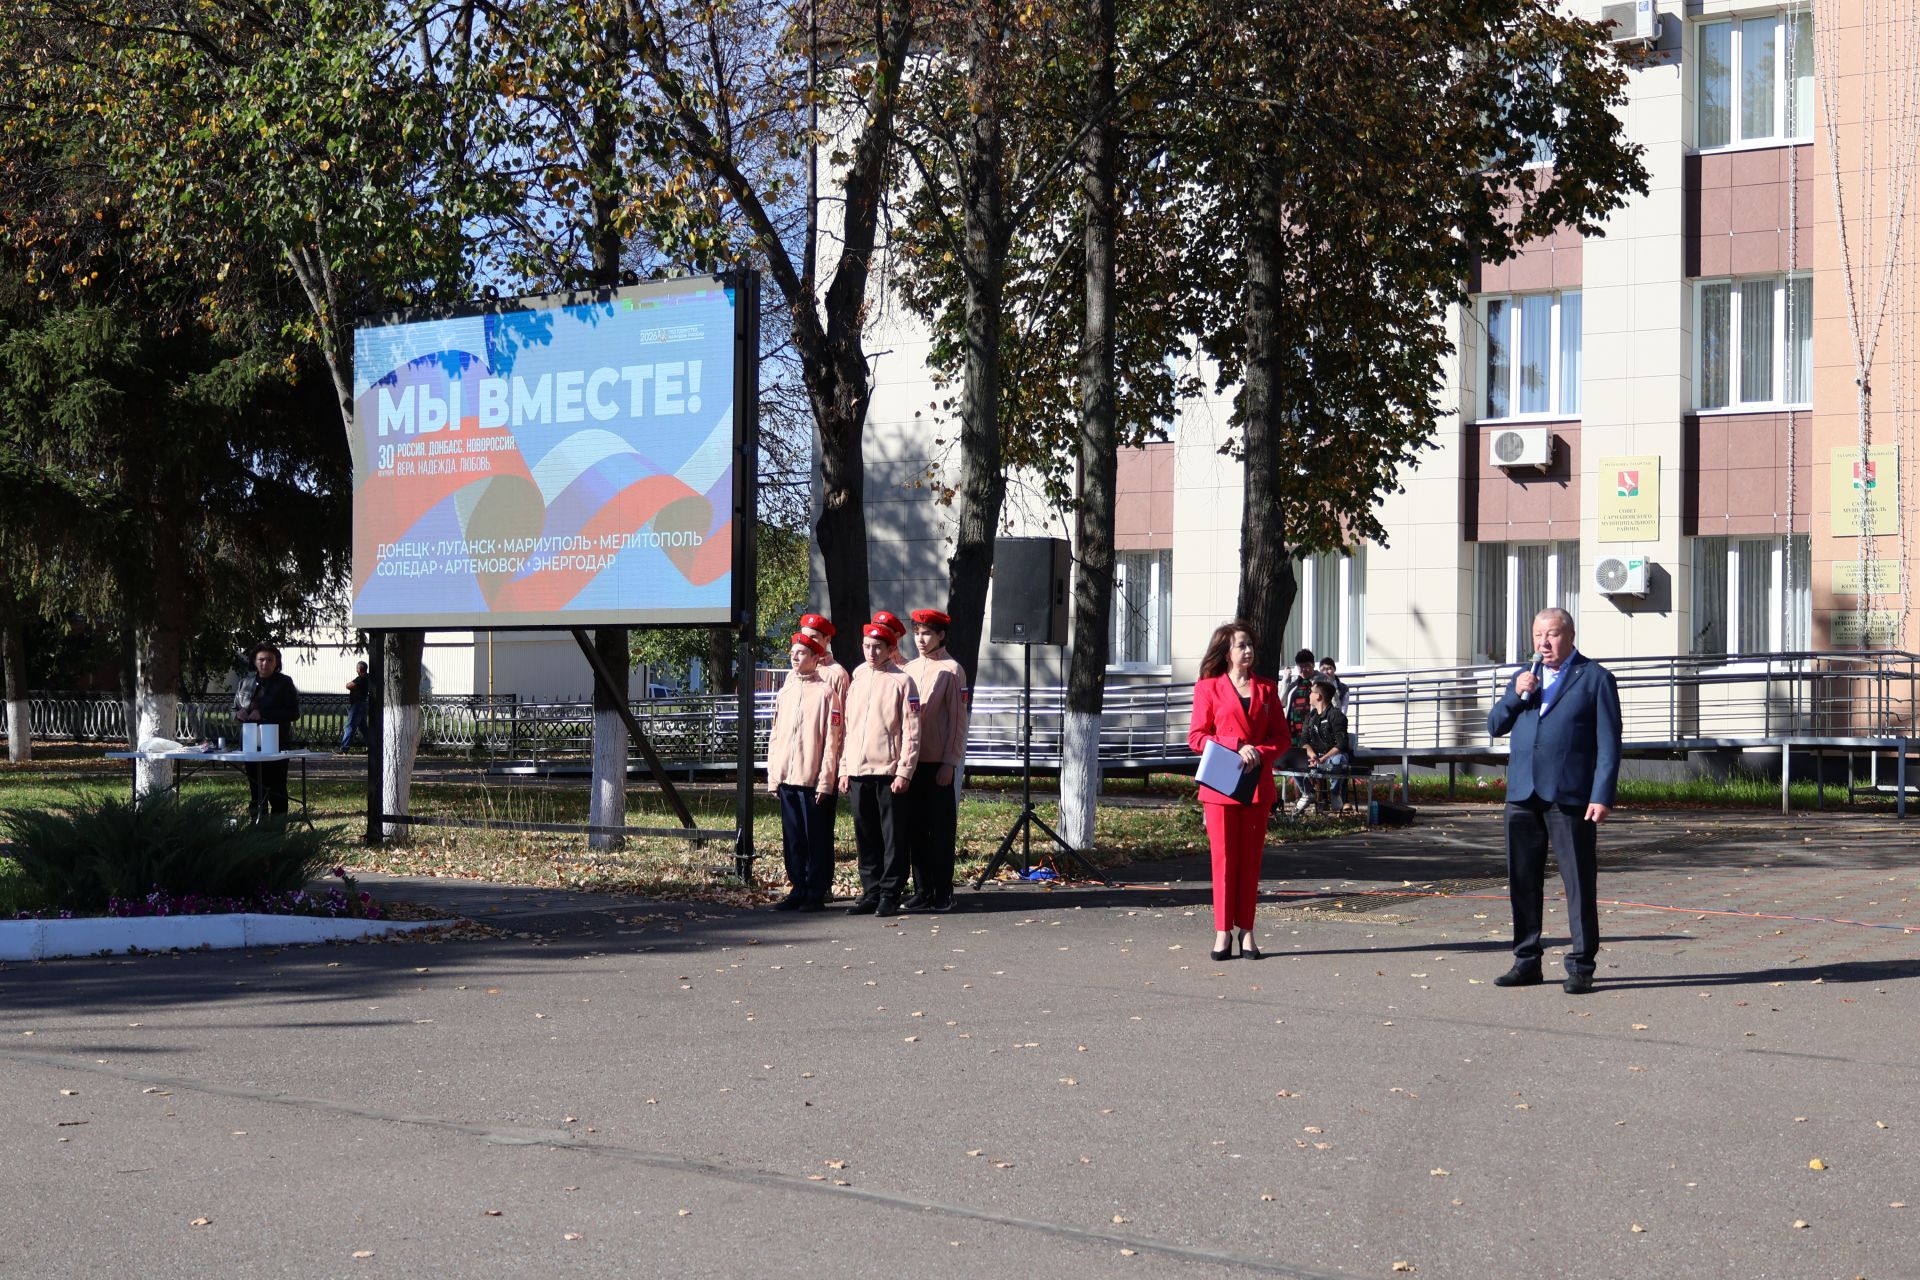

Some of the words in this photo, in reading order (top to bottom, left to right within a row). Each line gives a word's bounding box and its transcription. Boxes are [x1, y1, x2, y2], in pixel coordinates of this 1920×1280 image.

[378, 380, 461, 437] МЫ
[479, 360, 703, 430] ВМЕСТЕ!
[378, 444, 395, 470] 30
[397, 441, 427, 458] РОССИЯ.
[428, 438, 465, 456] ДОНБАСС.
[466, 435, 517, 453] НОВОРОССИЯ.
[397, 460, 417, 477] ВЕРА.
[418, 457, 458, 476] НАДЕЖДА.
